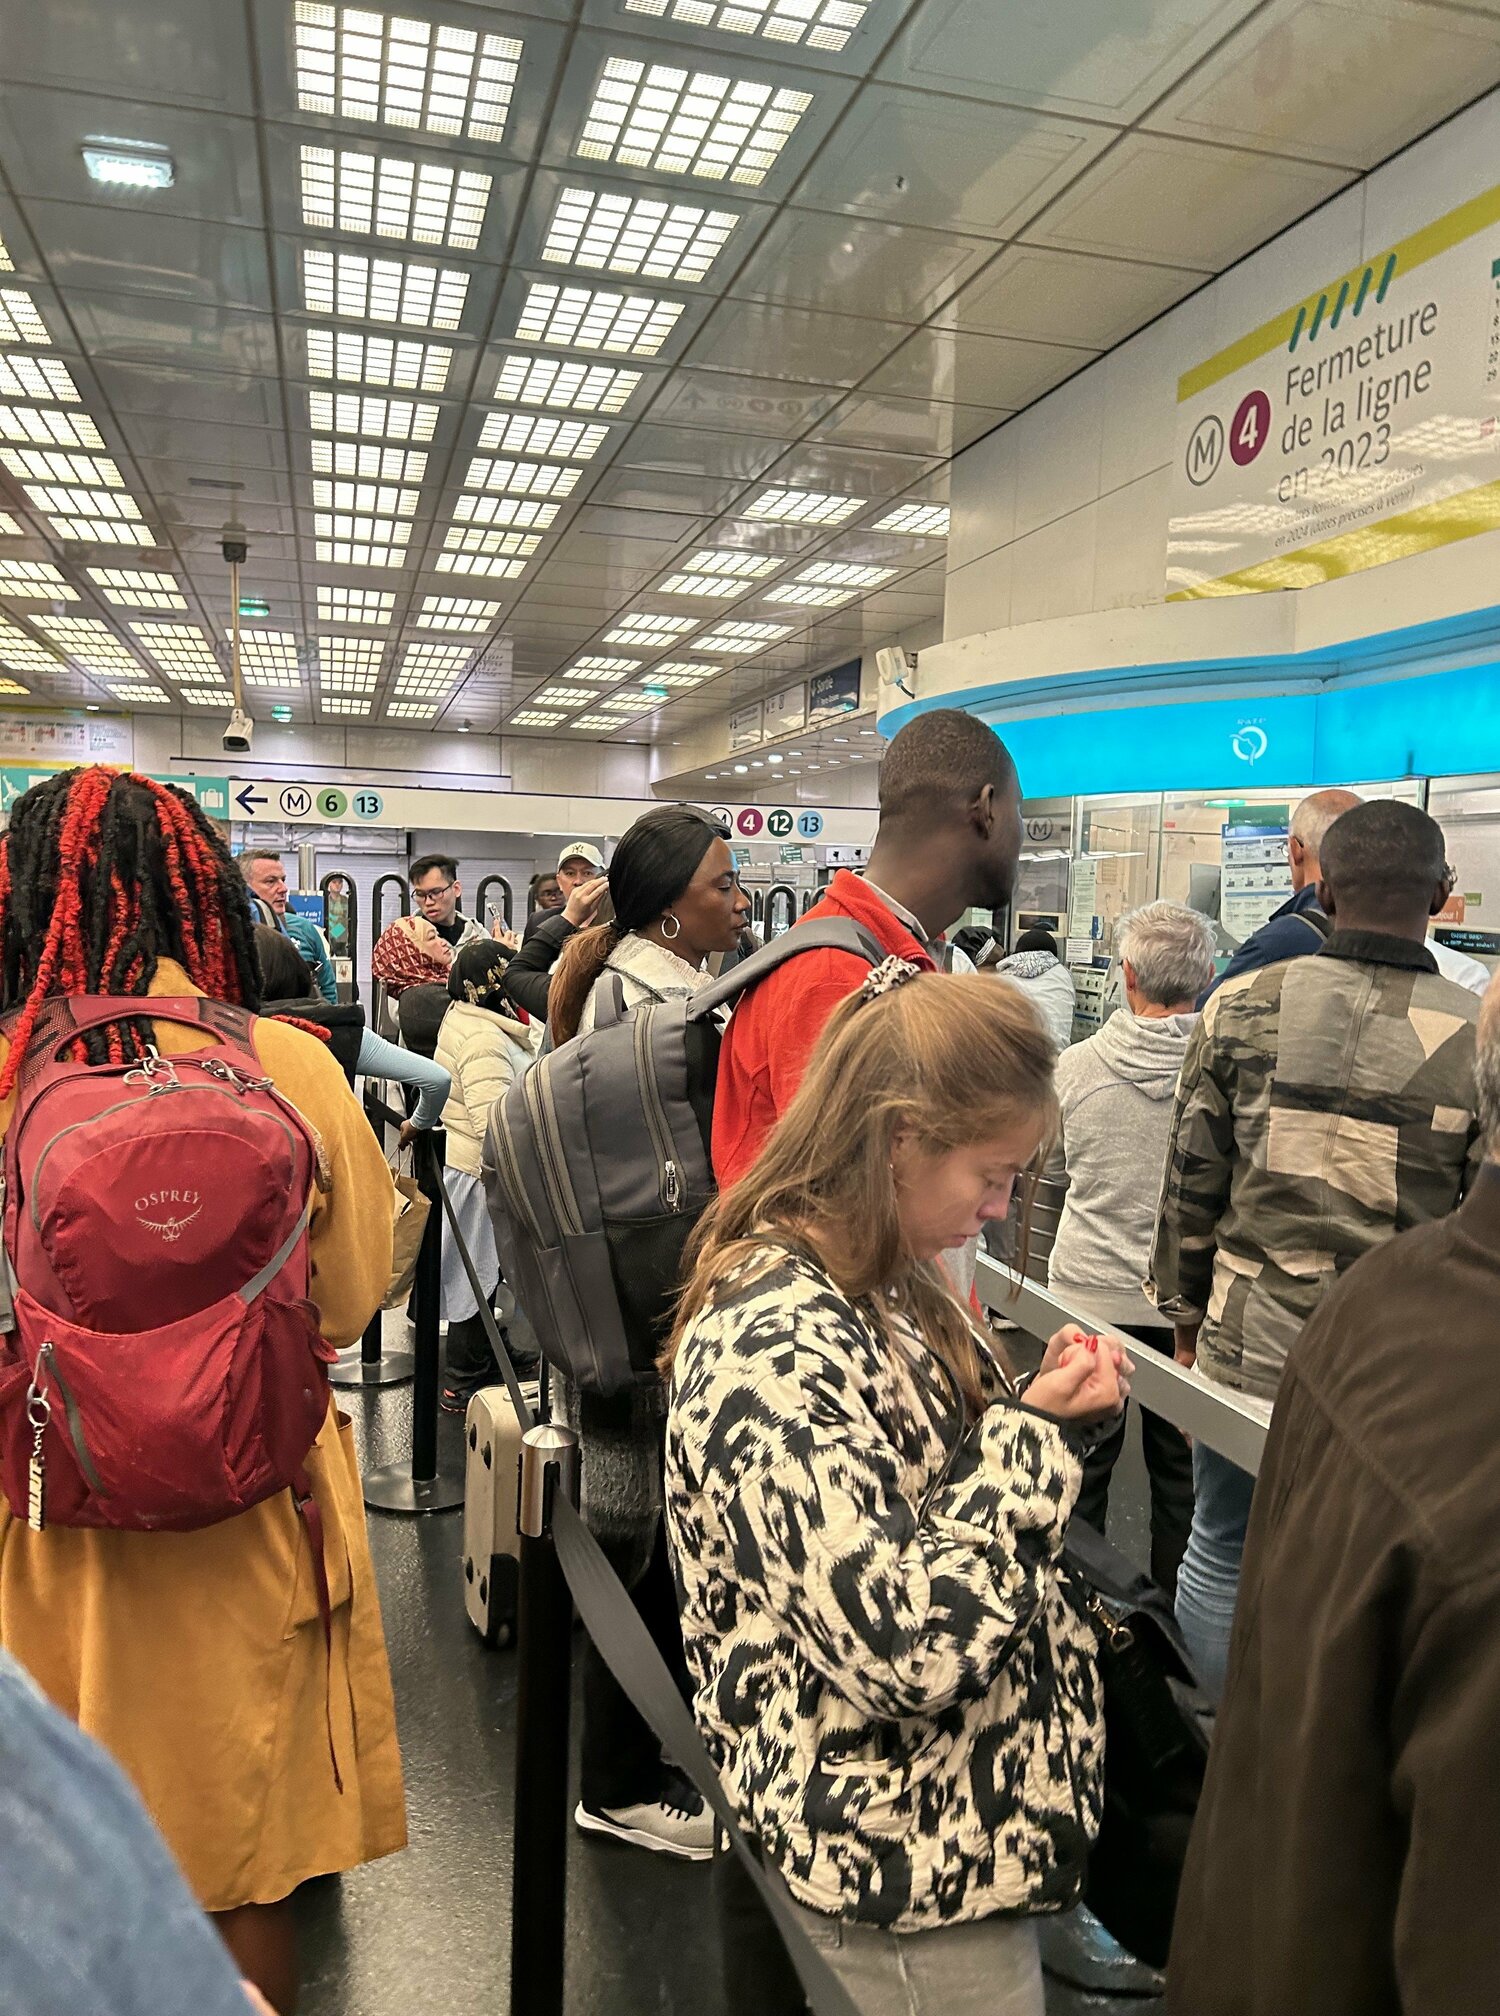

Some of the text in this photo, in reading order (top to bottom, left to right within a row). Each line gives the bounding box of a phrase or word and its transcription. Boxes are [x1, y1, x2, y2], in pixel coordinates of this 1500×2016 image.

[1286, 302, 1438, 406] Fermeture
[1239, 404, 1259, 449] 4
[1281, 360, 1432, 455] de la ligne
[1278, 467, 1309, 503] en
[1320, 422, 1392, 488] 2023
[325, 794, 338, 812] 6
[356, 796, 379, 814] 13
[742, 814, 756, 831] 4
[770, 815, 790, 832] 12
[801, 816, 820, 833] 13
[134, 1190, 201, 1211] OSPREY
